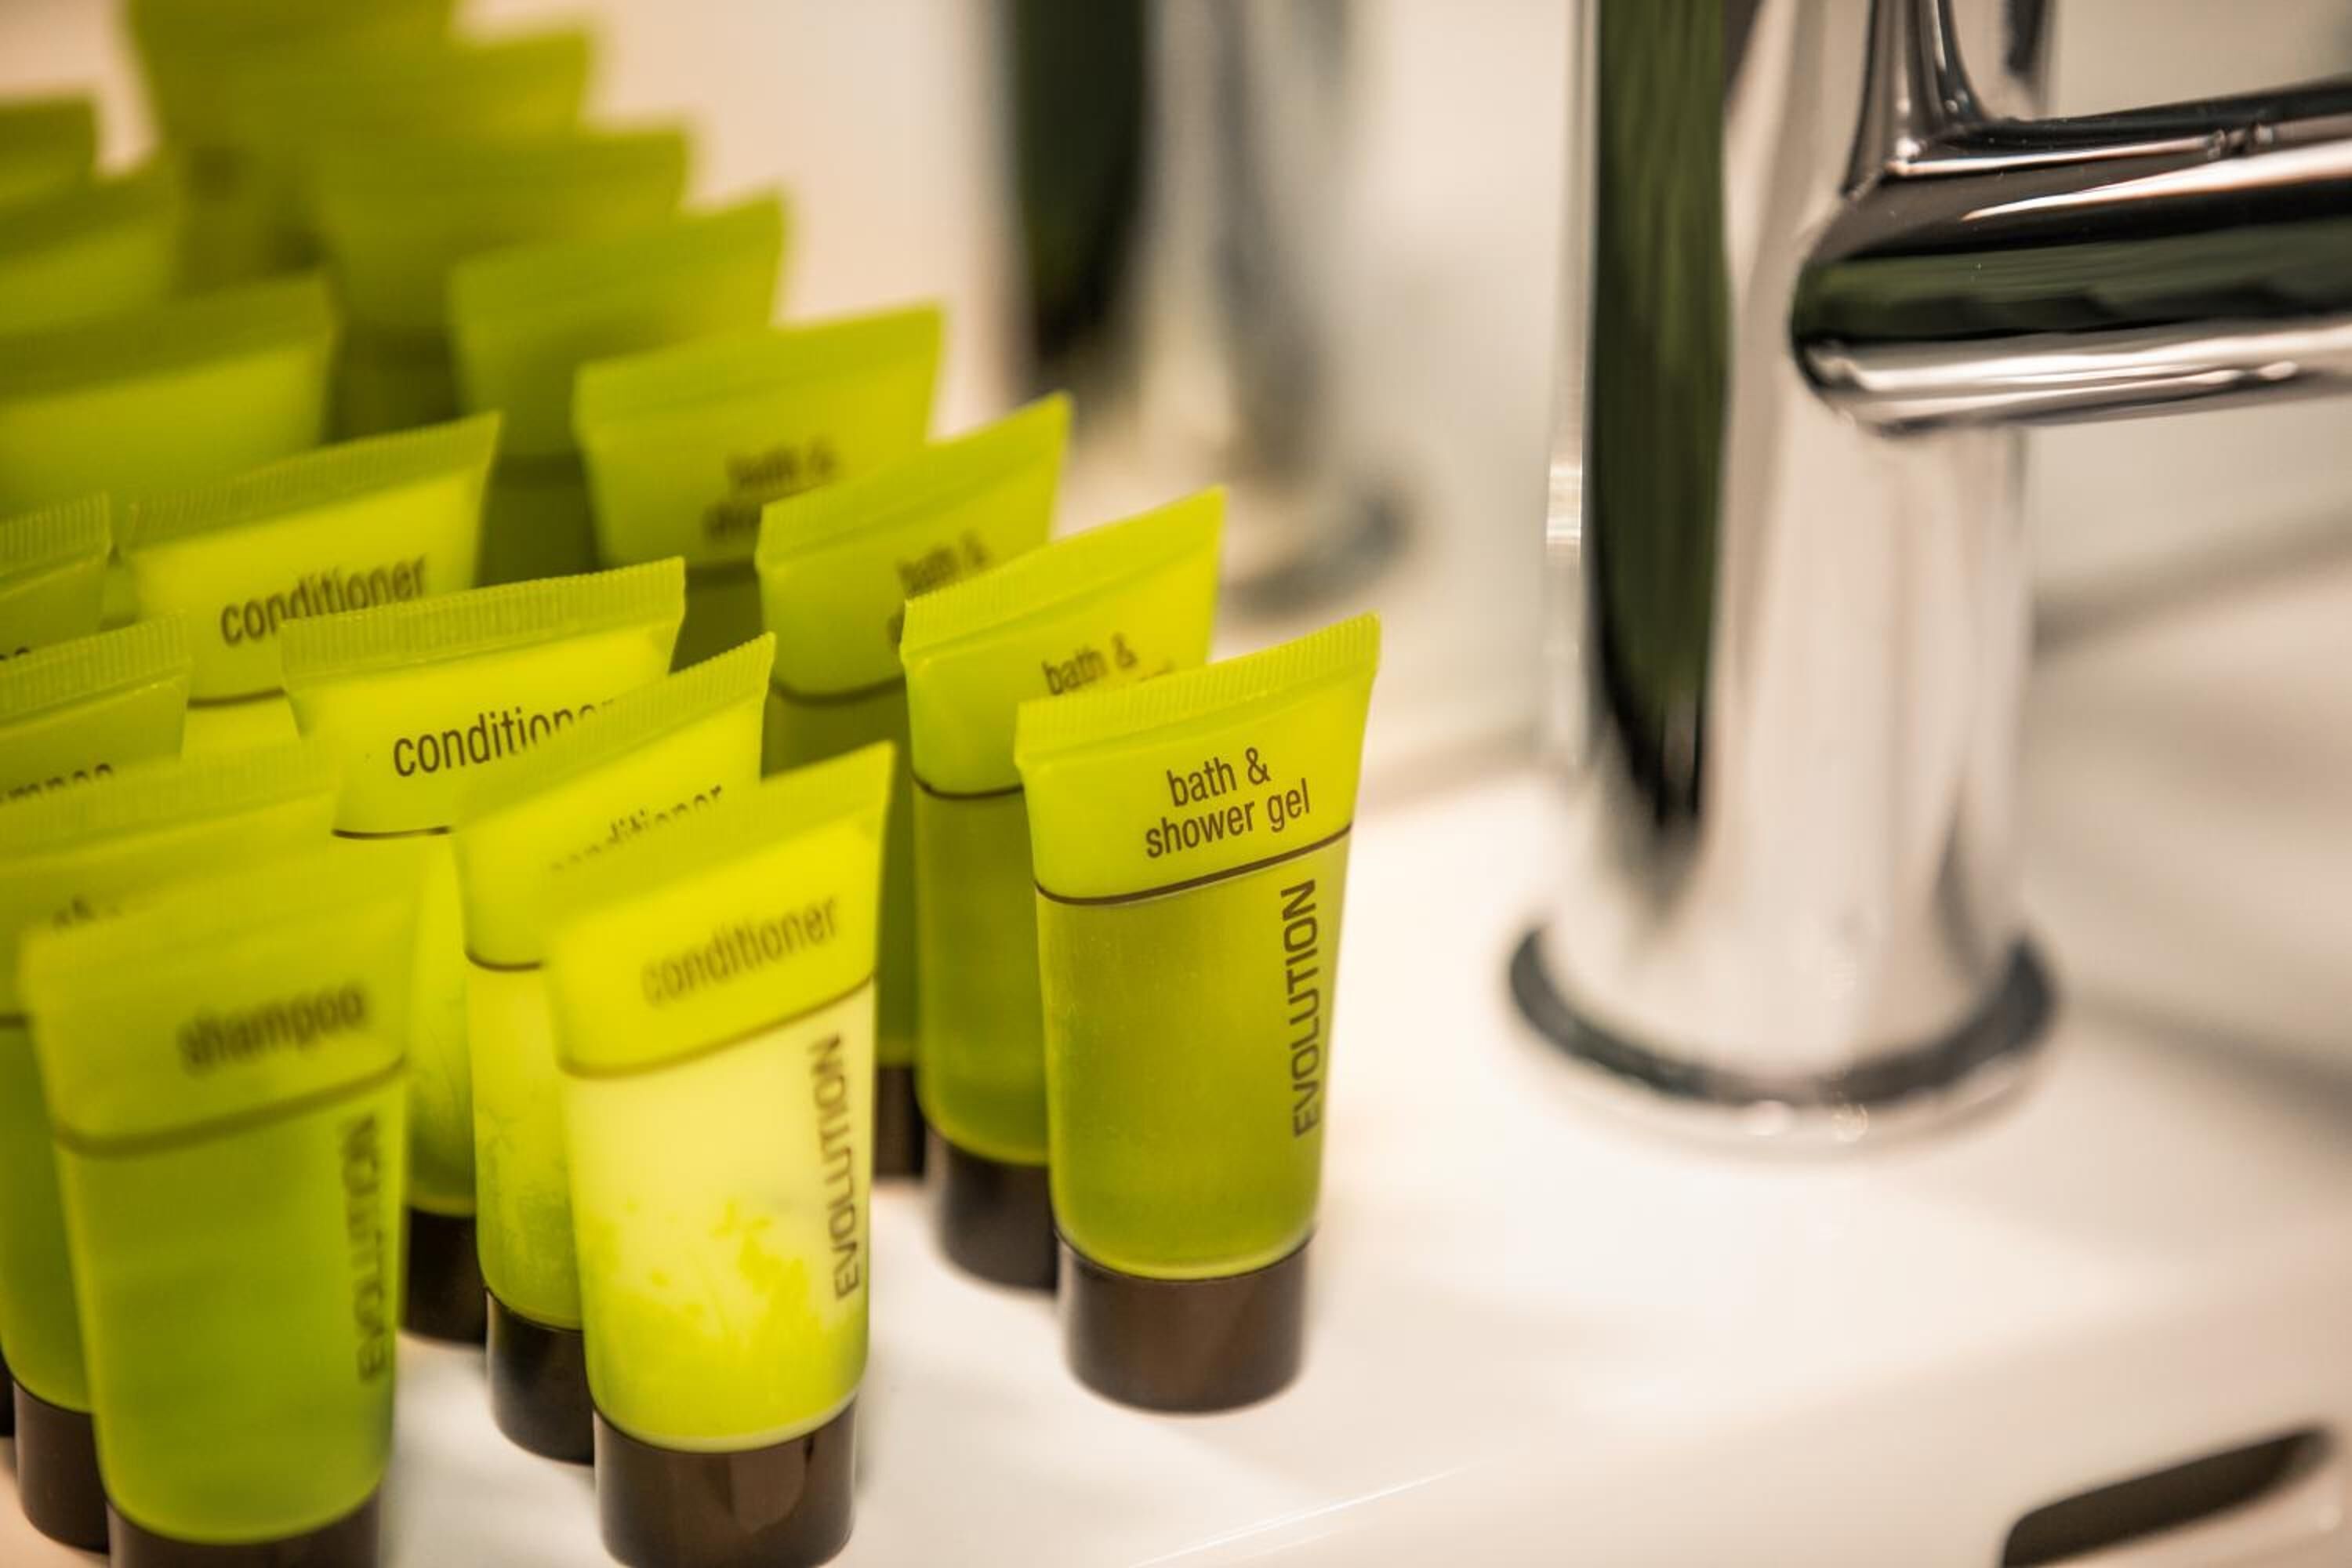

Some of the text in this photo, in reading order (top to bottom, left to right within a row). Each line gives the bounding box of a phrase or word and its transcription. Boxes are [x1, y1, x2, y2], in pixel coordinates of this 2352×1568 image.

[393, 698, 615, 777] condition
[1167, 746, 1271, 808] bath &
[1145, 777, 1310, 858] shower gel
[641, 895, 839, 1008] conditioner
[1280, 879, 1320, 1139] EVOLUTION
[807, 1034, 861, 1299] EVOLUTION
